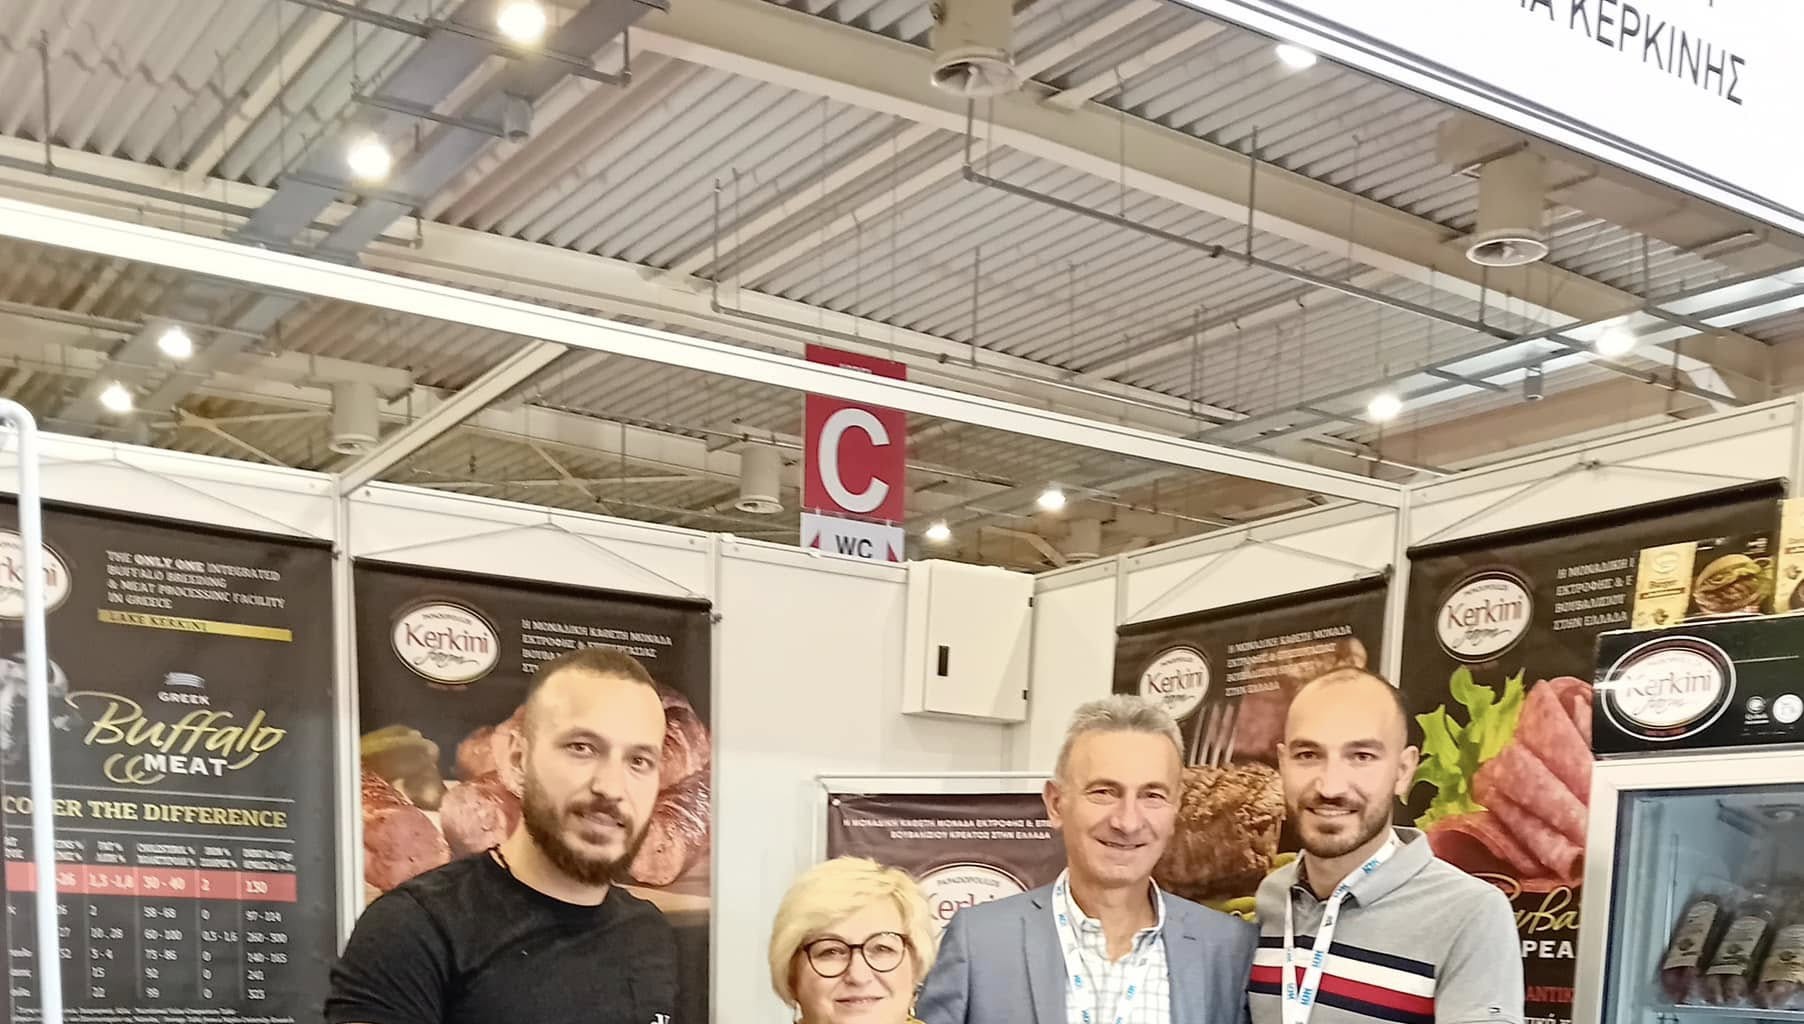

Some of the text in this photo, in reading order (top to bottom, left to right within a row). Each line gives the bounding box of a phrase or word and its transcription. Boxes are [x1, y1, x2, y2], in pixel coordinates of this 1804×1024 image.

[1570, 0, 1745, 105] ΚΕΡΚΙΝΗΣ
[817, 408, 891, 513] C
[835, 534, 873, 559] WC
[105, 550, 280, 582] THE ONLY ONE INTEGRATED
[166, 571, 227, 589] BREEDING
[107, 579, 285, 608] & MEAT PROCESSING FACILITY
[107, 591, 172, 609] IN GREECE
[1448, 595, 1524, 629] Kerkini
[404, 622, 489, 654] Kerkini
[1147, 666, 1204, 694] Kerkini
[1626, 669, 1713, 699] Kerkini
[65, 691, 287, 756] Buffalo
[144, 753, 228, 777] MEAT
[3, 796, 288, 828] COER THE DIFFERENCE
[1521, 940, 1577, 958] ΡΕΑ
